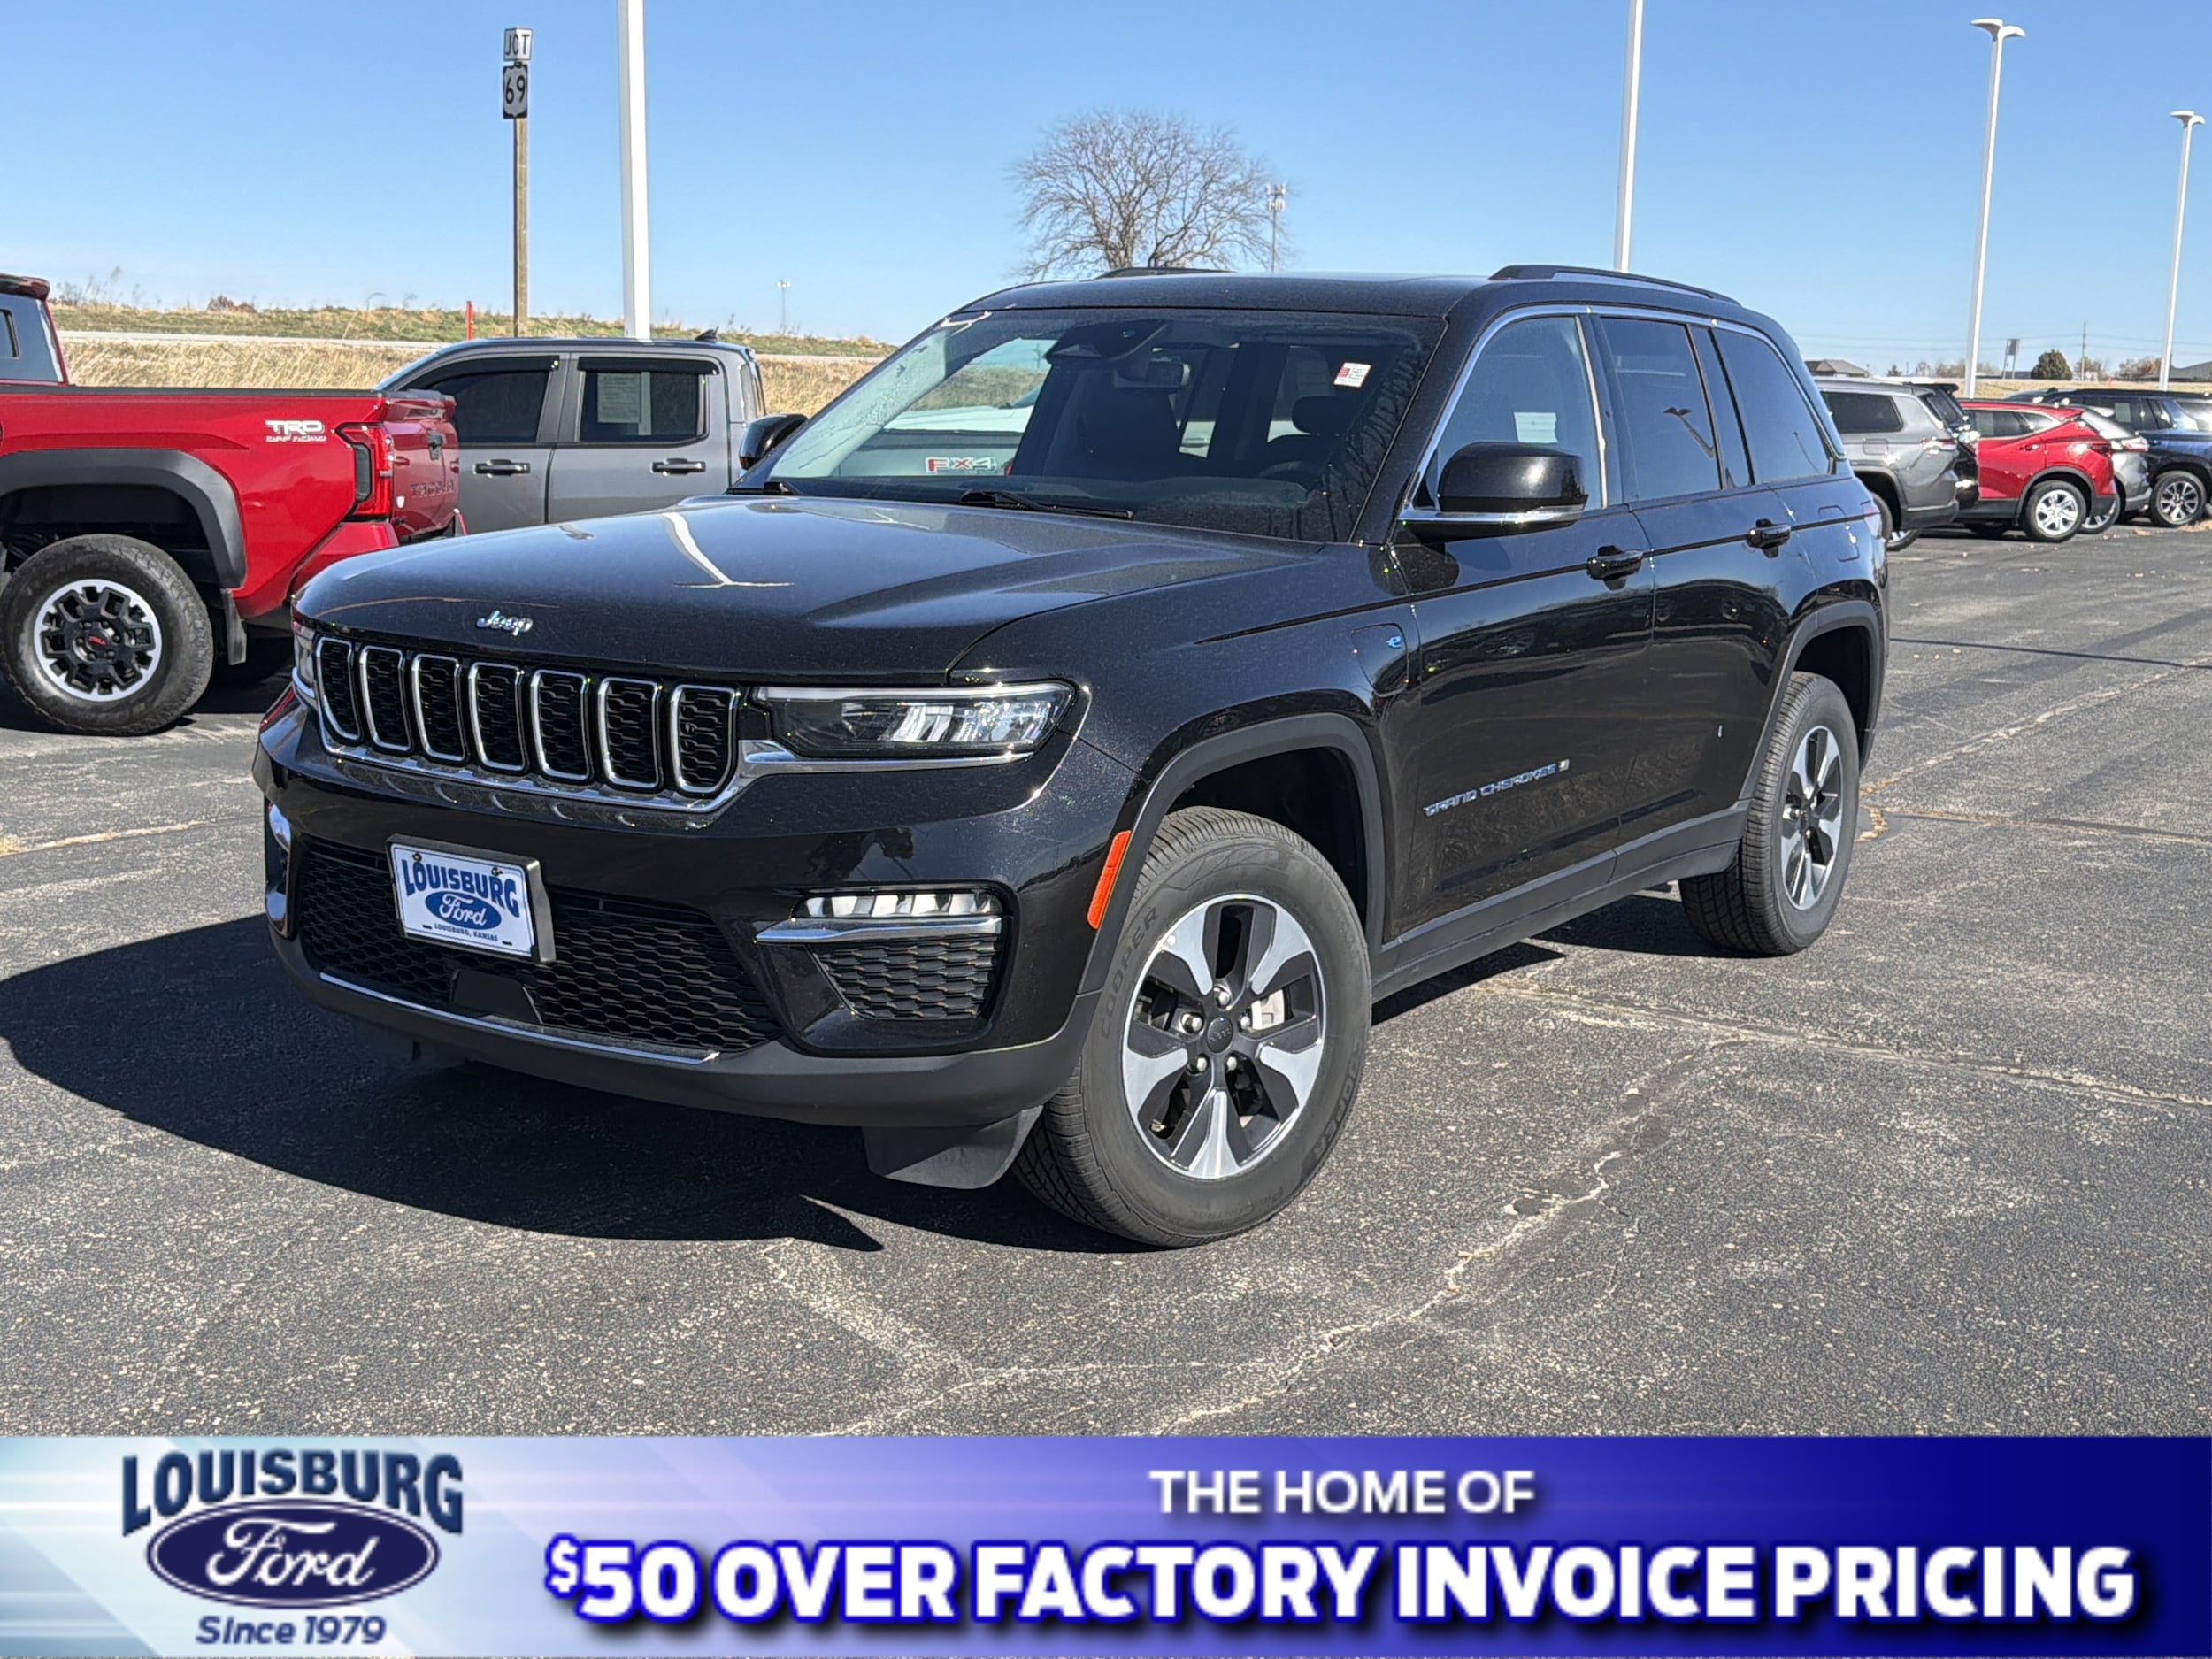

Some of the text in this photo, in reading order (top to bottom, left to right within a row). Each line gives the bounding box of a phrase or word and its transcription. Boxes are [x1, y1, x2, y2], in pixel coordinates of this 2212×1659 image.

[504, 34, 531, 56] JCT
[505, 74, 526, 104] 69
[265, 419, 325, 435] TRD
[926, 457, 997, 474] FX4
[476, 610, 534, 636] Jeep
[1423, 763, 1557, 817] GRAND CHEROKEE
[401, 858, 520, 918] LOUISBURG
[439, 893, 487, 926] Ford
[473, 930, 498, 942] KANSAS
[1101, 905, 1157, 1039] COOPER
